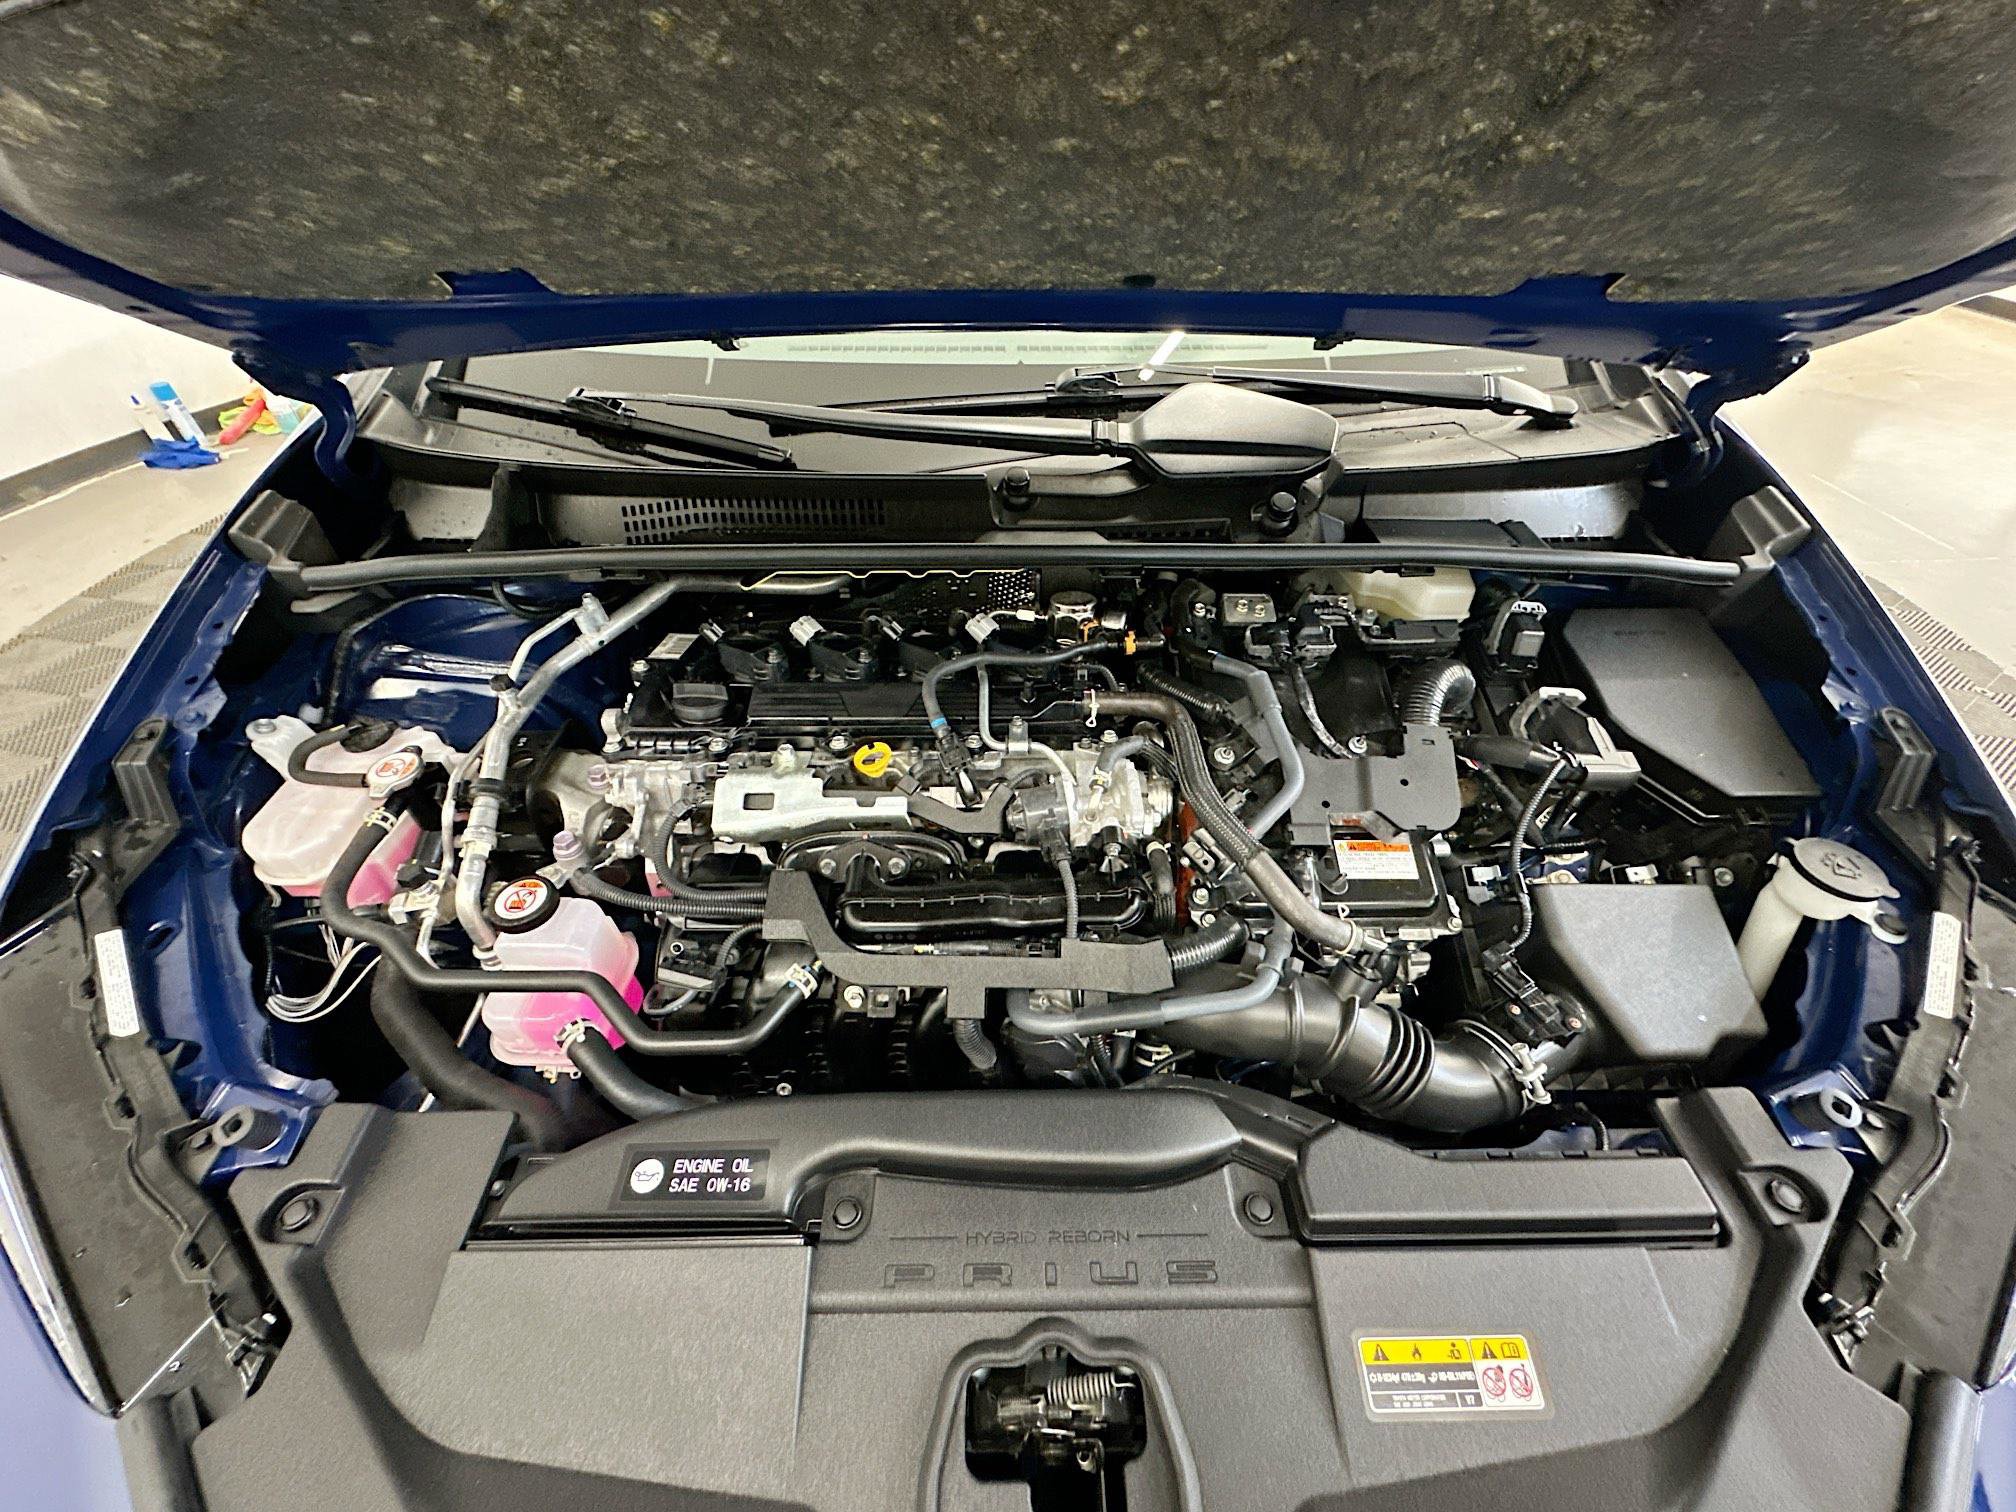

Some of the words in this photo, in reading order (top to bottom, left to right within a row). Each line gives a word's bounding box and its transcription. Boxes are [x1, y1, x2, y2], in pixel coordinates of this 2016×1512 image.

[673, 1159, 725, 1173] ENGINE
[732, 1158, 754, 1173] OIL
[669, 1178, 699, 1192] SAE
[706, 1178, 751, 1192] 0W-16
[966, 1231, 1037, 1245] HYBRID
[1049, 1230, 1130, 1244] REBORN
[884, 1261, 1218, 1289] PRIUS
